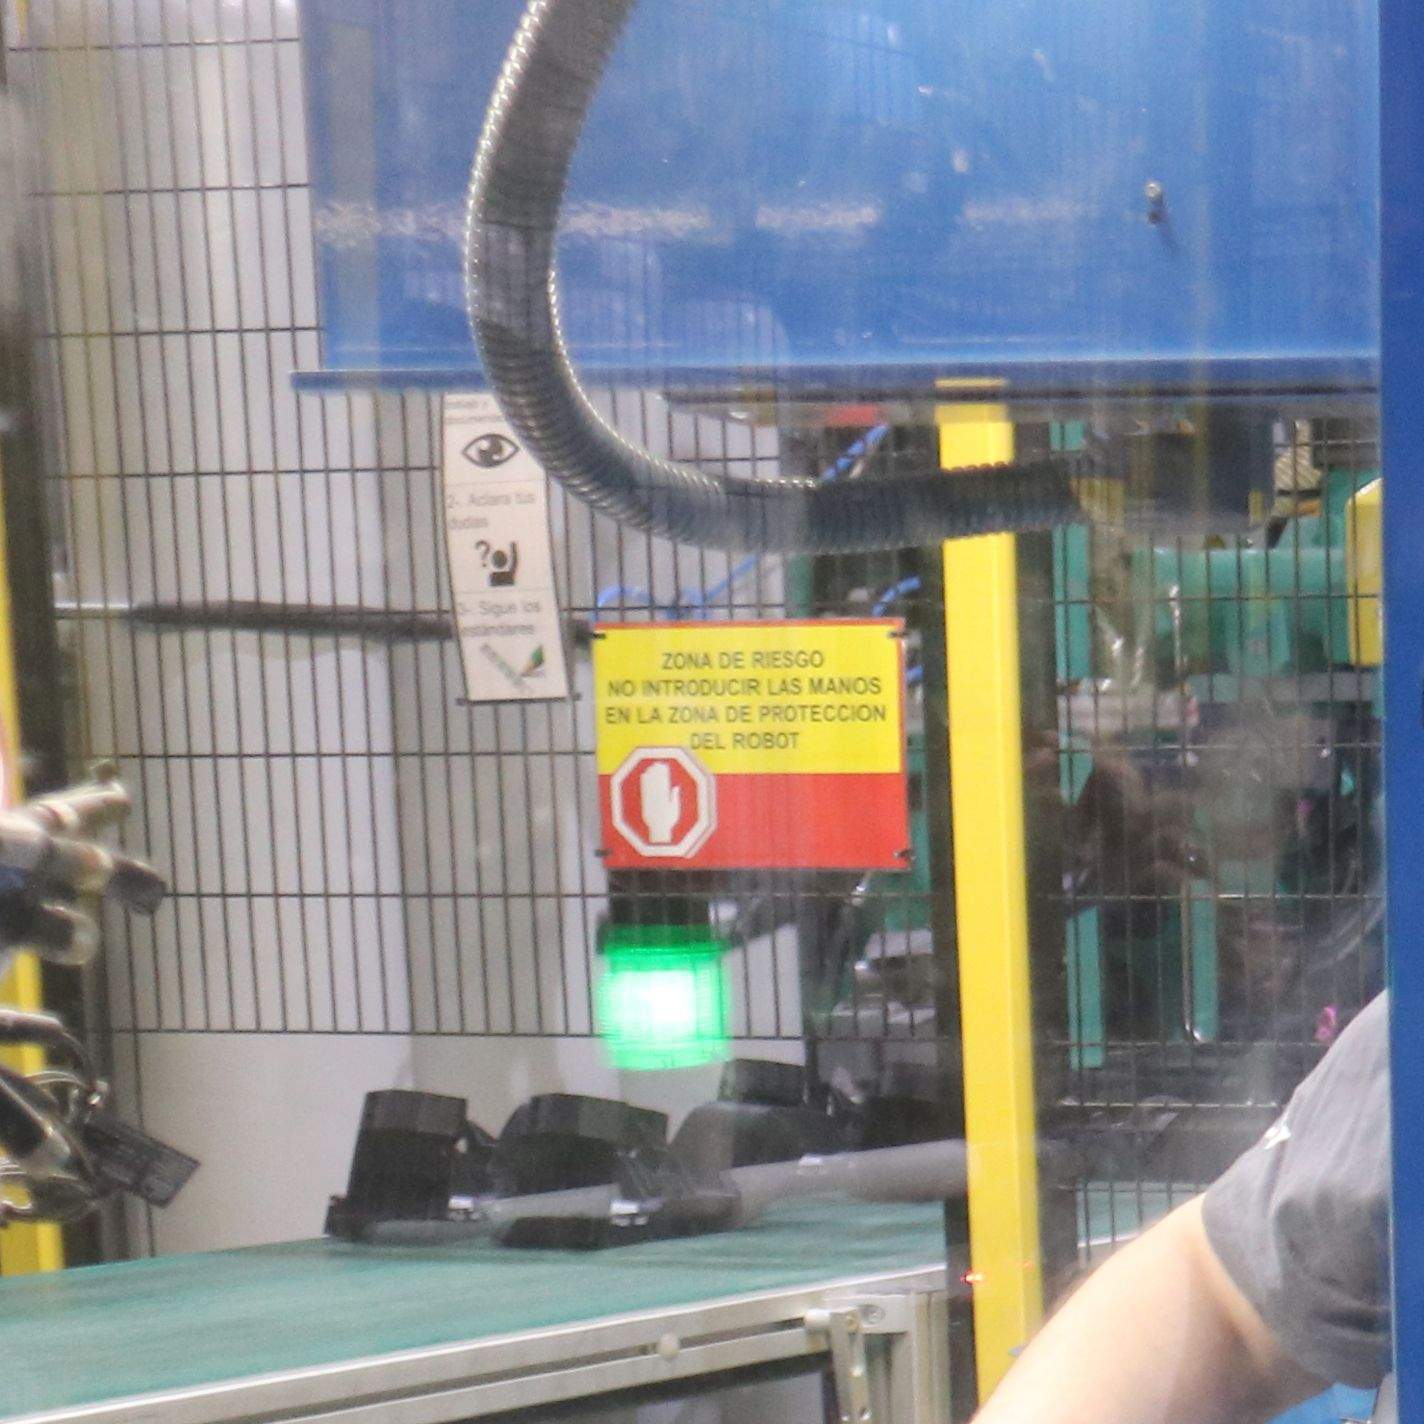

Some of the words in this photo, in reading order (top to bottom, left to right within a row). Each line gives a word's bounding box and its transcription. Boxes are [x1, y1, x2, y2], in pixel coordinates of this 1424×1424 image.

[661, 651, 713, 670] ZONA
[719, 651, 746, 669] DE
[752, 650, 825, 669] RIESGO
[608, 680, 635, 698] NO
[641, 679, 760, 697] INTRODUCIR
[767, 678, 802, 696] LAS
[807, 677, 882, 695] MANOS
[605, 706, 632, 724] EN
[637, 706, 662, 724] LA
[668, 706, 718, 724] ZONA
[725, 705, 751, 723] DE
[758, 704, 887, 723] PROTECCION
[690, 732, 725, 750] DEL
[732, 732, 800, 750] ROBOT
